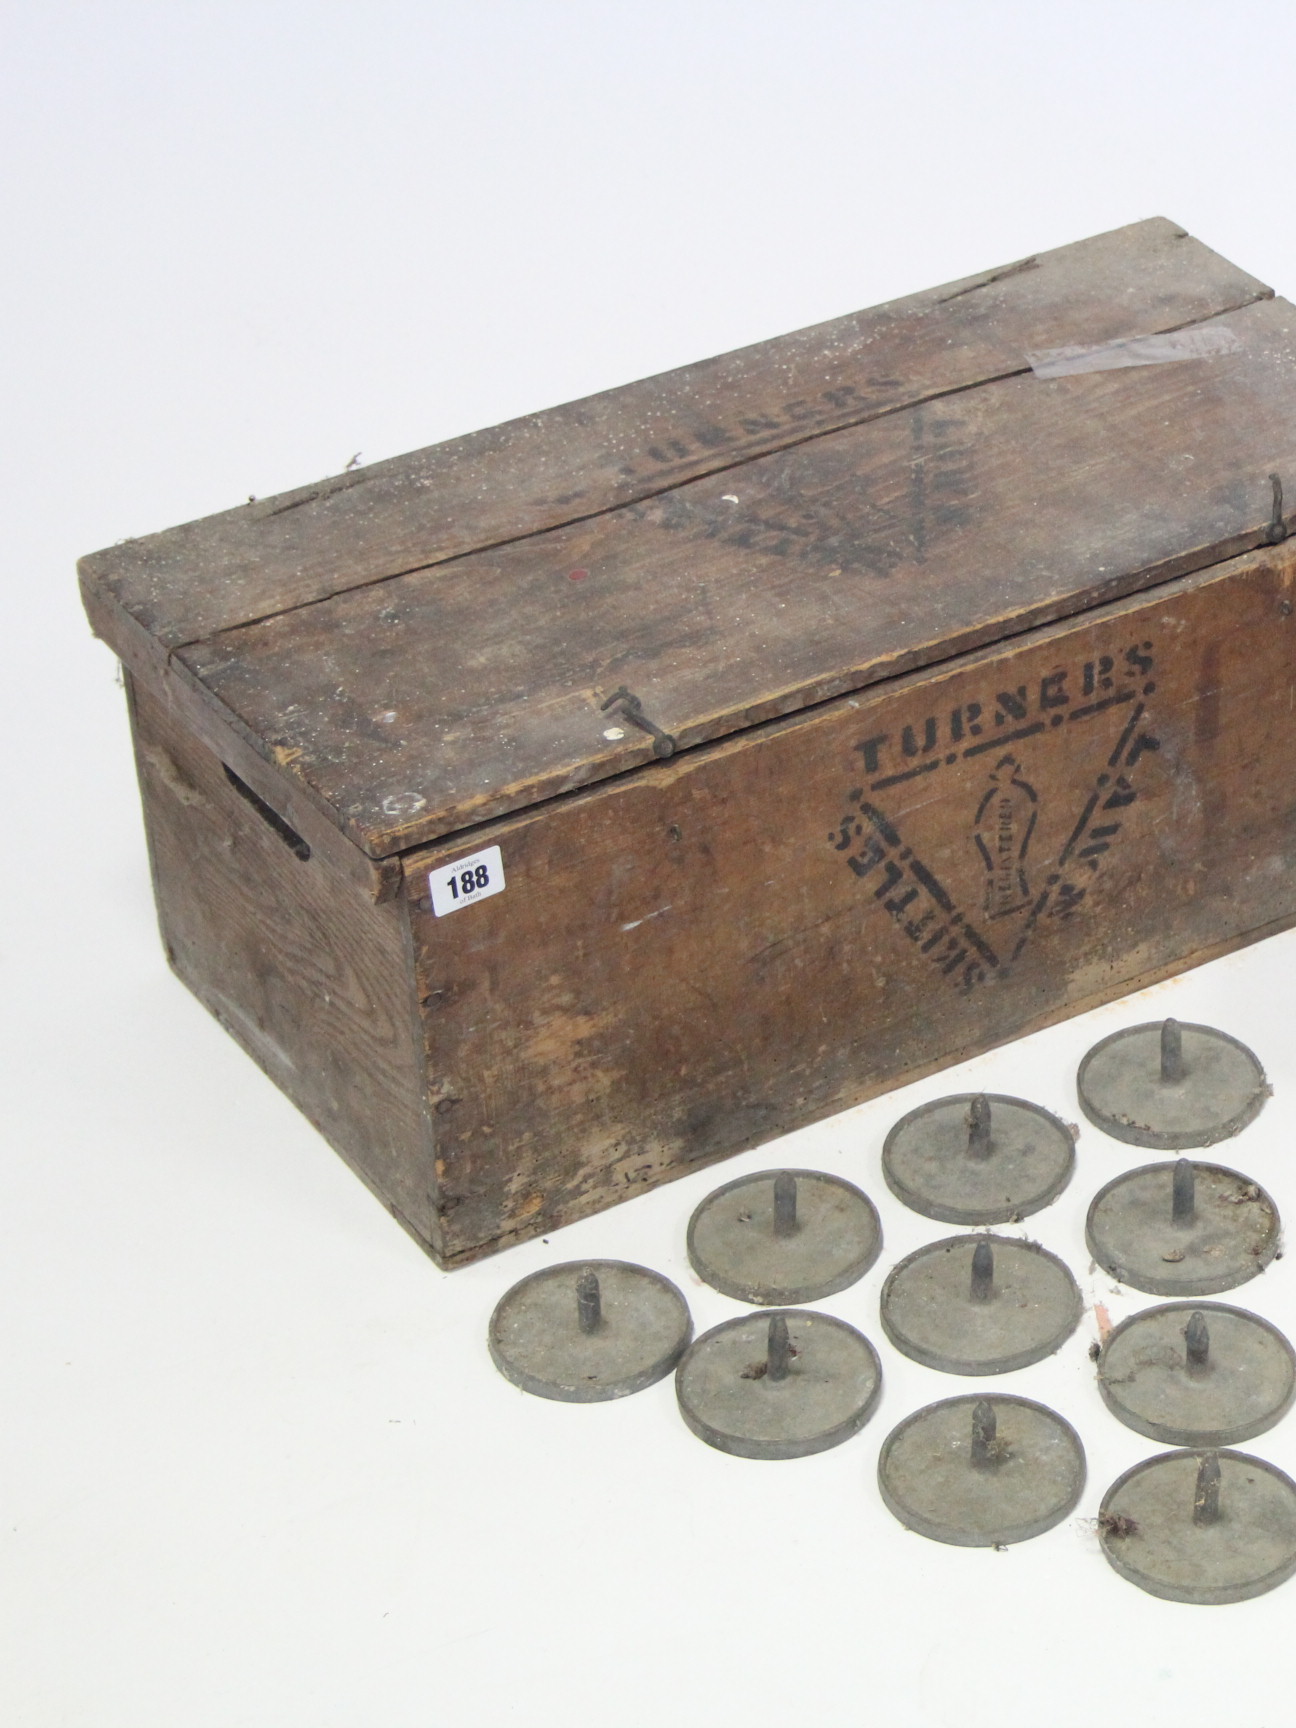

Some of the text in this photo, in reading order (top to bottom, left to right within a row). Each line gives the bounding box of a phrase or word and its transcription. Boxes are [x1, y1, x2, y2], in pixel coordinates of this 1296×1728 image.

[853, 641, 1153, 774] TURNERS
[447, 864, 490, 899] 188
[451, 859, 480, 873] Aldridges
[467, 892, 482, 901] Bath
[828, 814, 986, 992] SKITTLES
